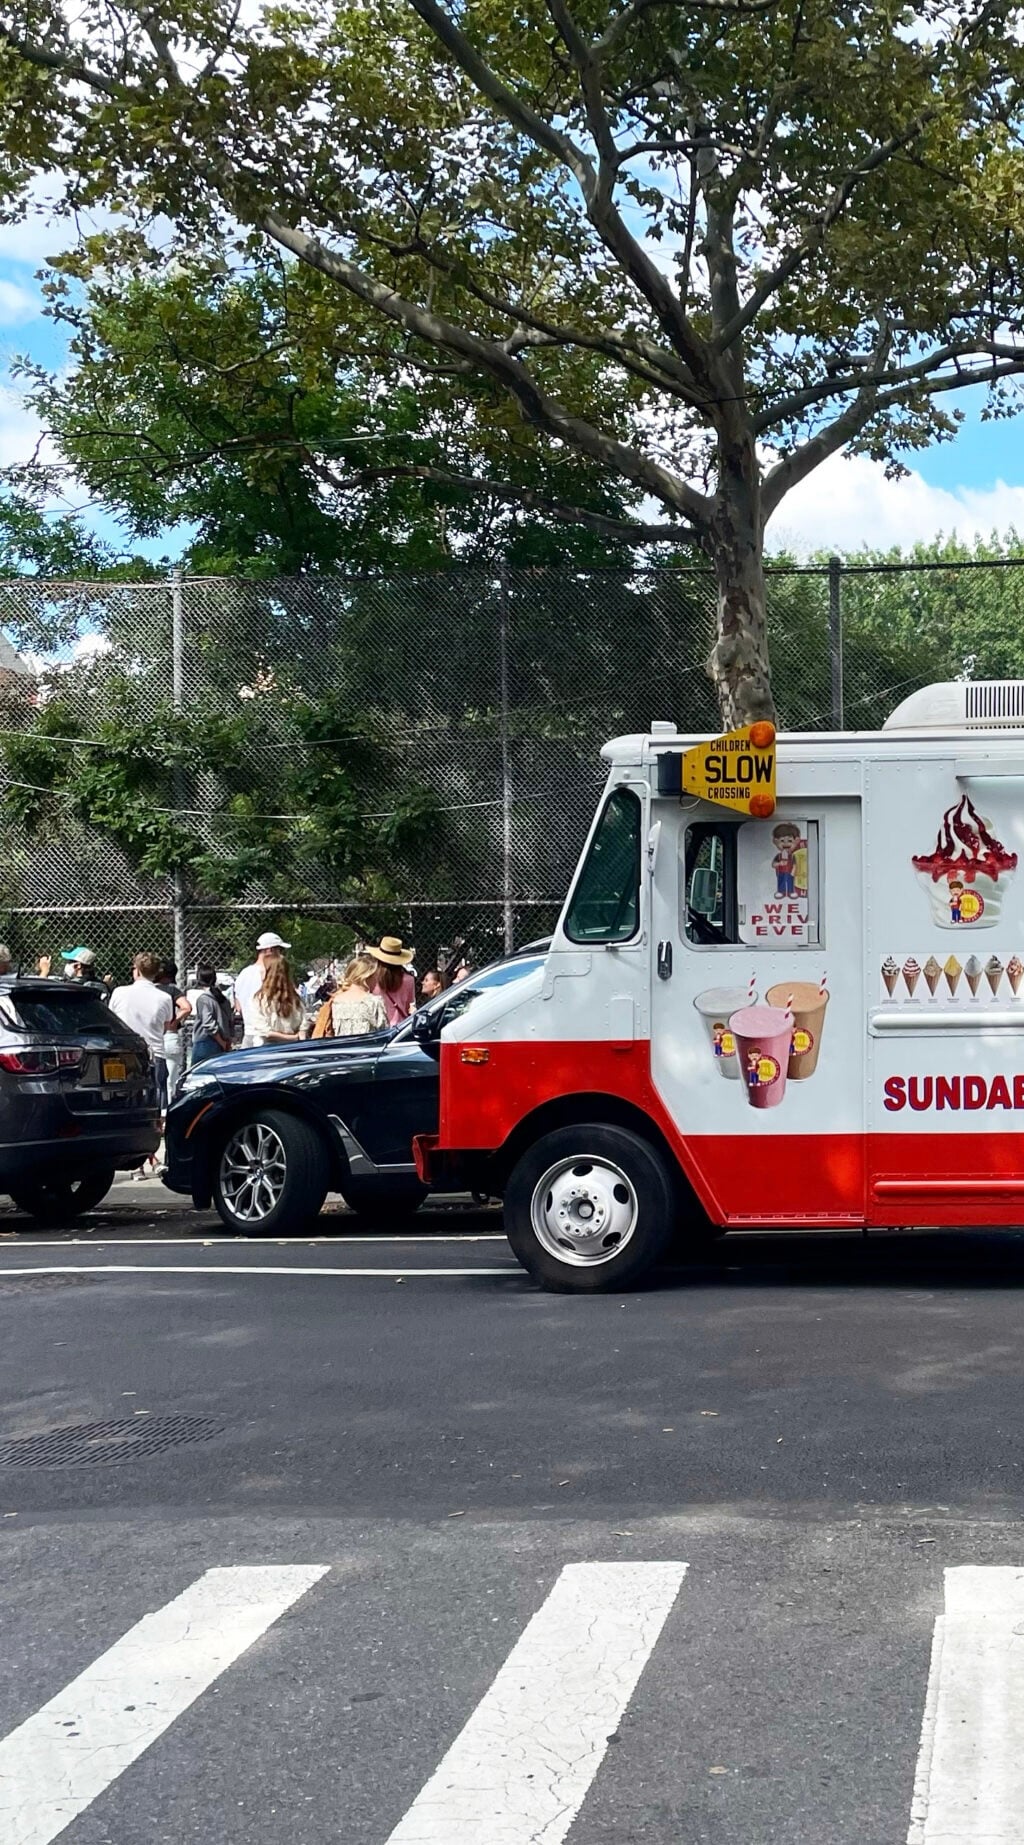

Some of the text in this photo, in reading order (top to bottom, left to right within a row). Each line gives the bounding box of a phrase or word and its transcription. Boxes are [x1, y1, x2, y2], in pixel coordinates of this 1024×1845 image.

[710, 740, 750, 752] CHILDREN
[705, 755, 774, 783] SLOW
[708, 787, 750, 799] CROSSING
[764, 903, 800, 914] WE
[751, 914, 809, 925] PRIV
[756, 925, 804, 936] EVE
